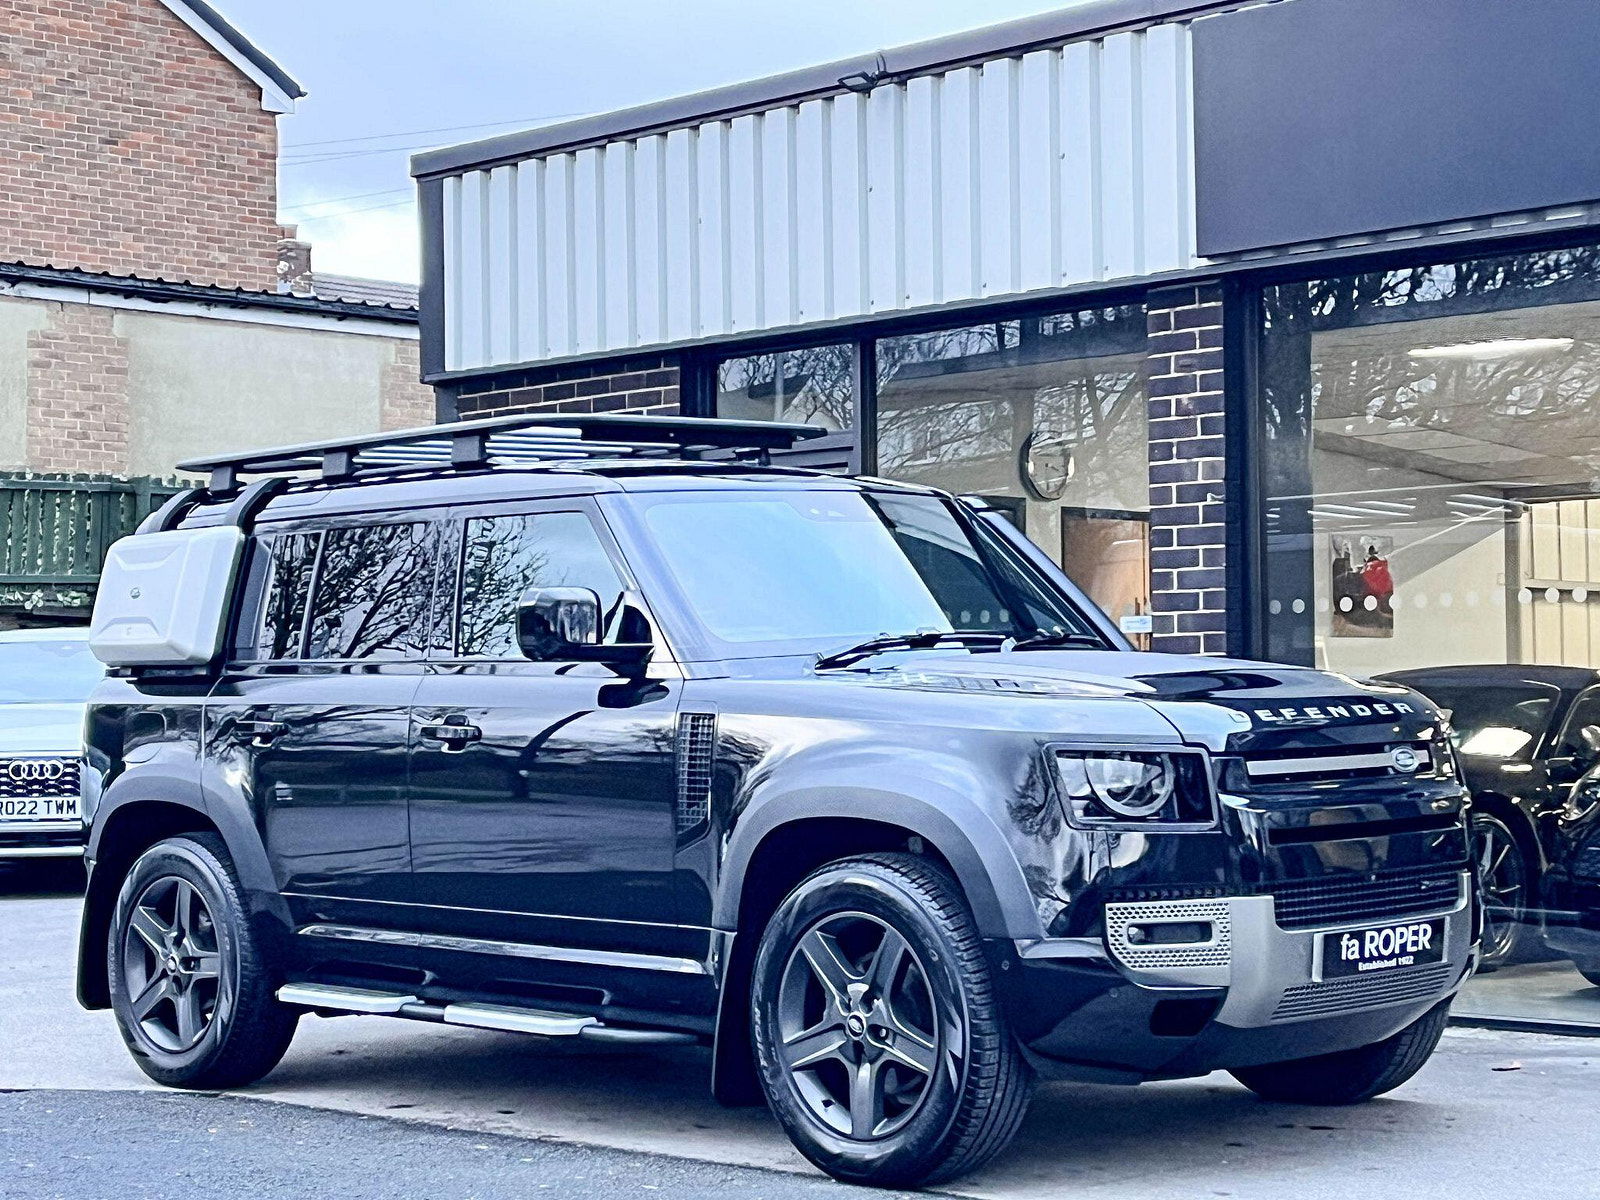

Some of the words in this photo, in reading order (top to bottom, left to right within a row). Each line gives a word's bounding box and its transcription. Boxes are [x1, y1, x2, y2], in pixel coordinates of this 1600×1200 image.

[1227, 702, 1414, 723] DEFENDER
[44, 800, 77, 815] TWM
[1340, 933, 1360, 960] fa
[1364, 923, 1432, 958] ROPER
